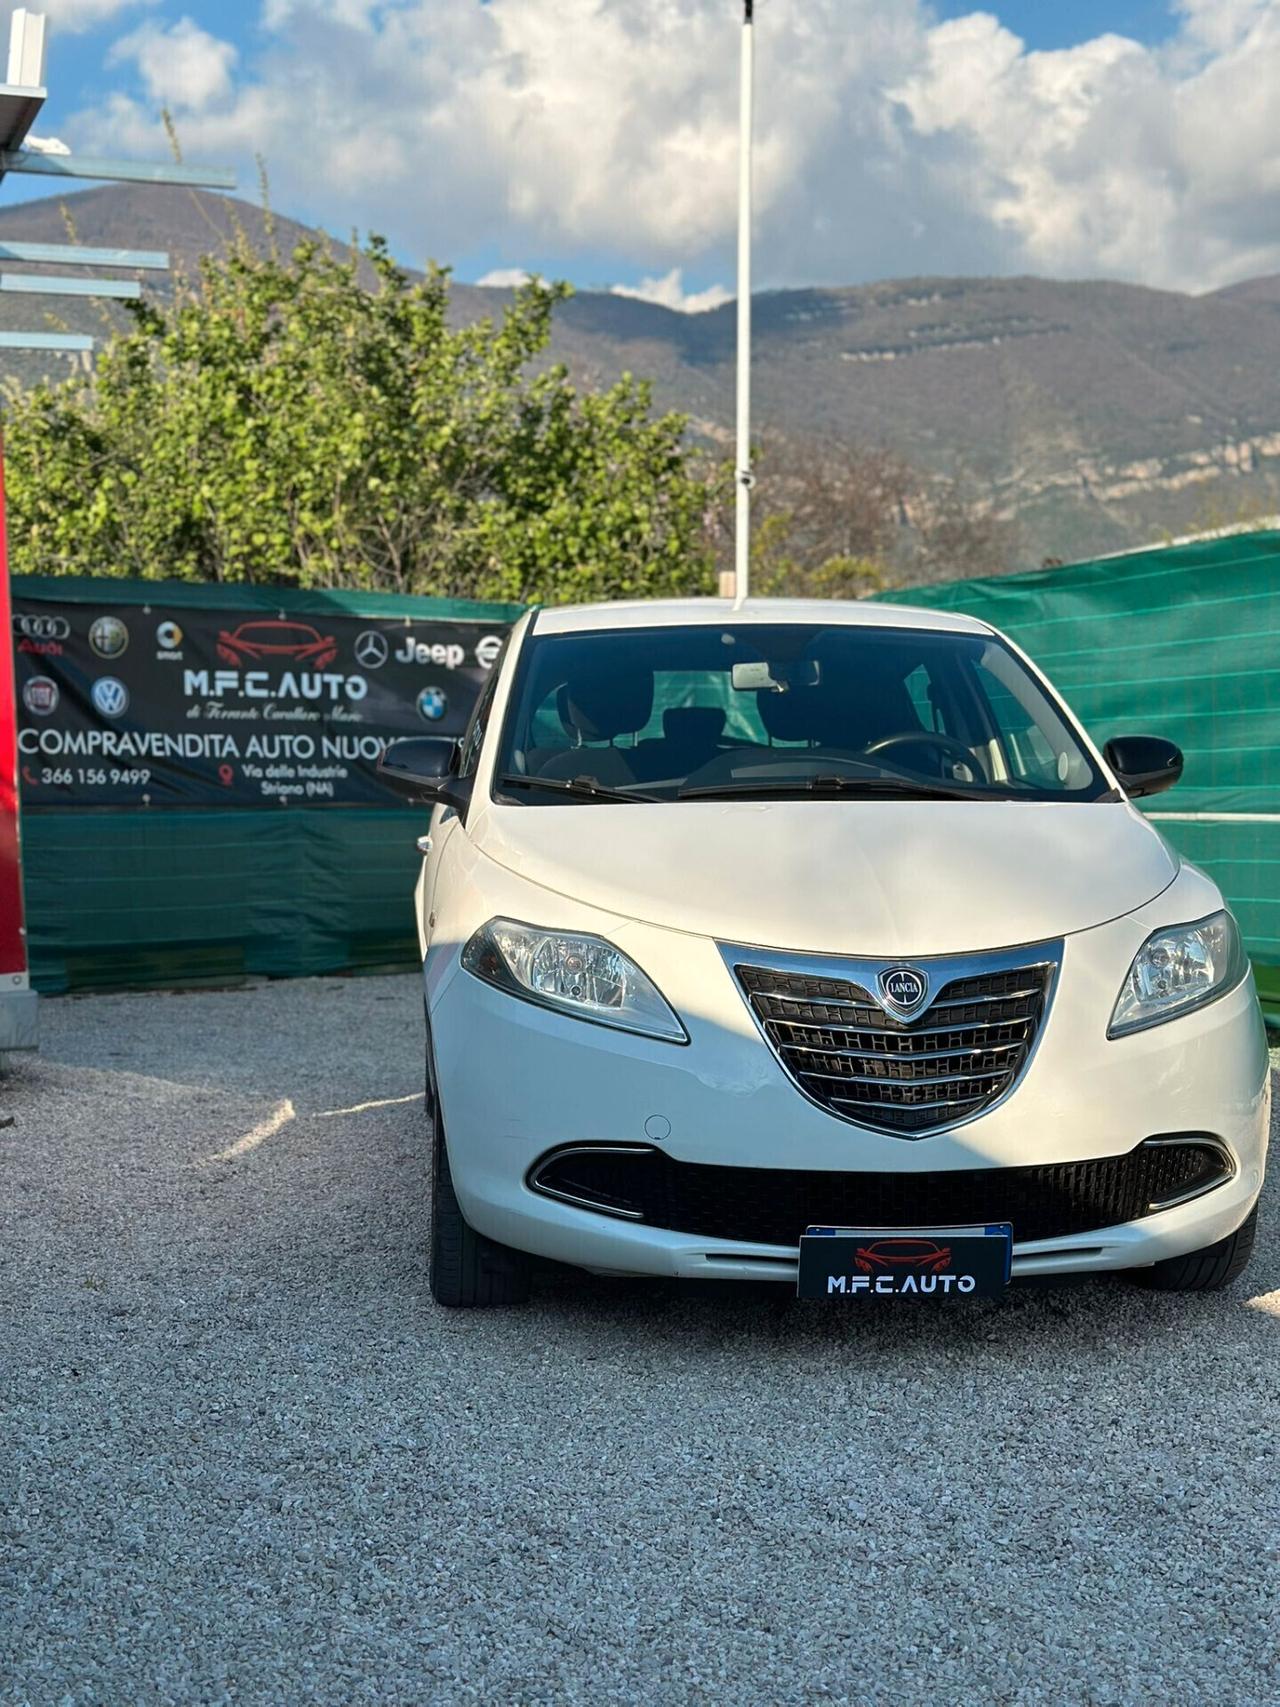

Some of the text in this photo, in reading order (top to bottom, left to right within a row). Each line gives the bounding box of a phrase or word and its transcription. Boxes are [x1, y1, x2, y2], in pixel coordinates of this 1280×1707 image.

[17, 639, 63, 656] Audi
[395, 637, 465, 670] Jeep
[183, 669, 368, 701] M.F.C.AUTO
[17, 728, 240, 759] COMPRAVENDITA
[245, 734, 315, 760] AUTO
[41, 768, 151, 785] 366 156 9499
[241, 764, 263, 778] Via
[890, 982, 919, 993] LANCIA
[827, 1275, 976, 1294] M.F.C.AUTO
